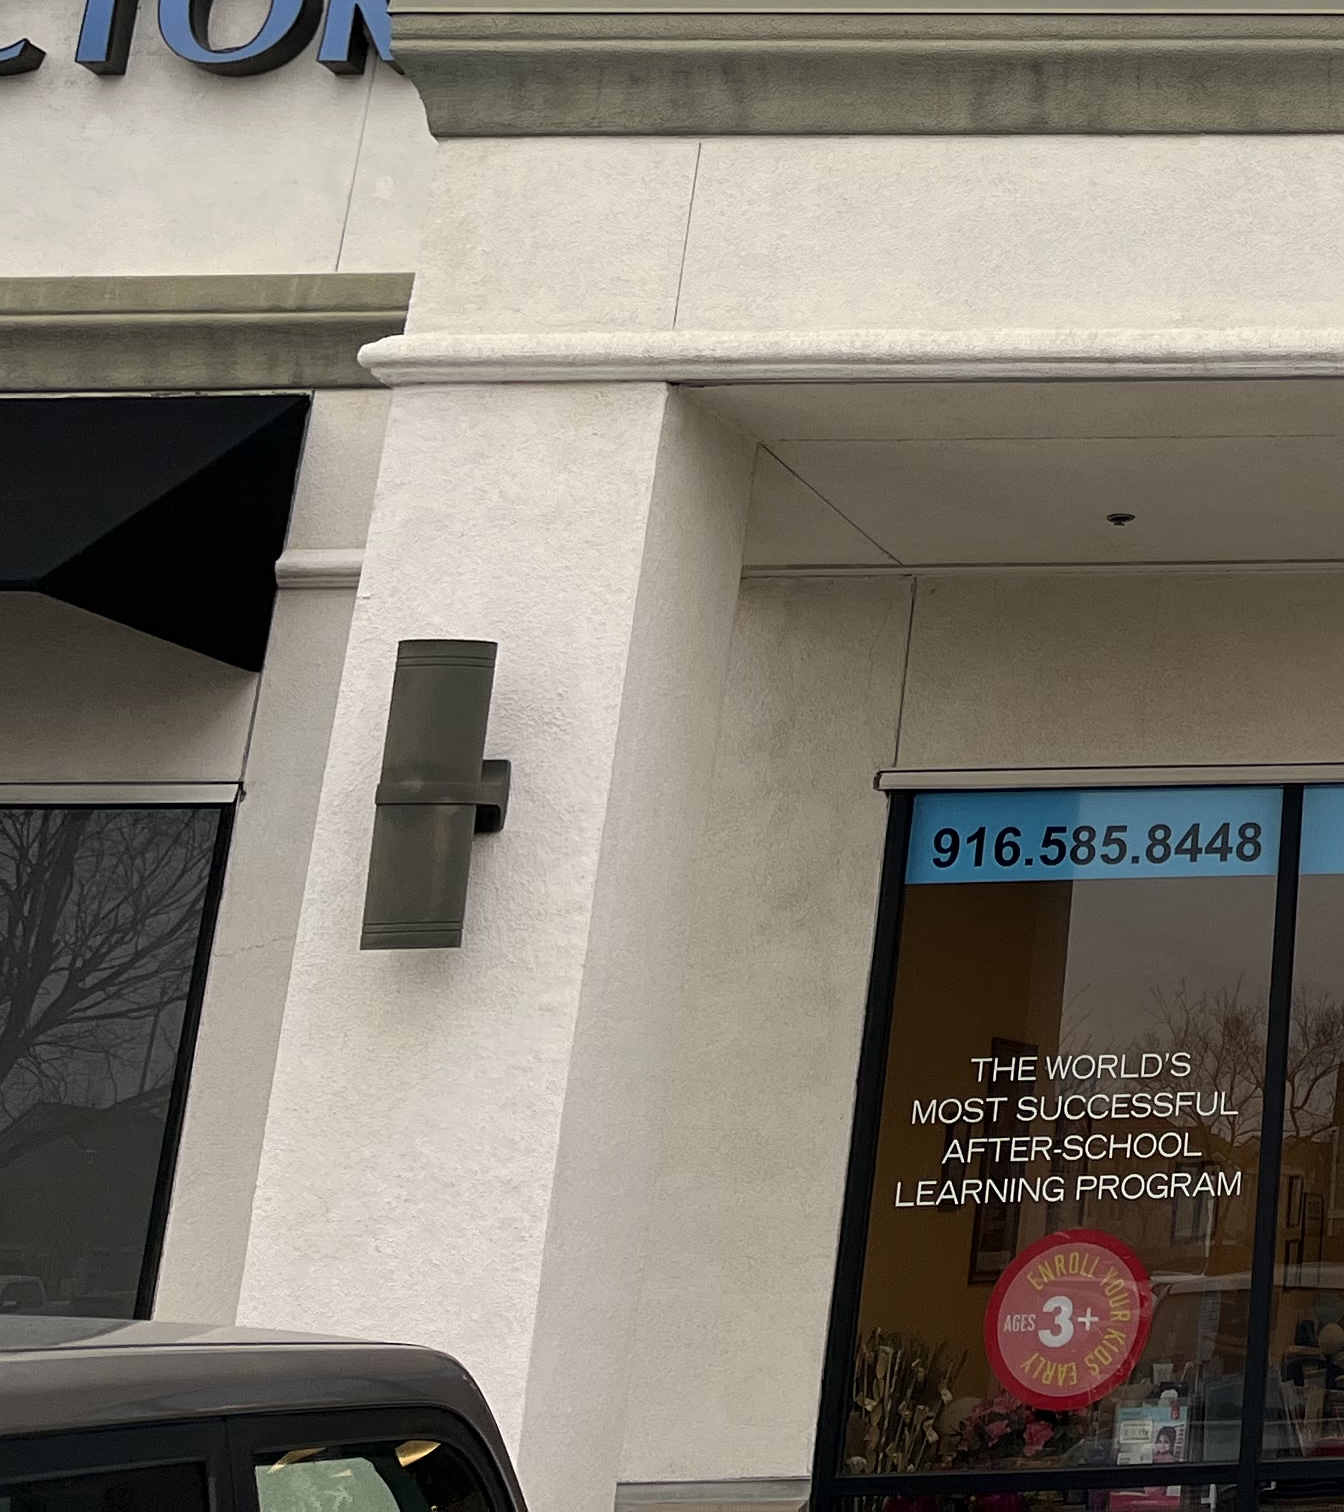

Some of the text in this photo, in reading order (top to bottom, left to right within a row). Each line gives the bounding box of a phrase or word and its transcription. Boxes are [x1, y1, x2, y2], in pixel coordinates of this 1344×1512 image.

[932, 822, 1262, 868] 916.585.8448
[971, 1052, 1192, 1082] THE WORLD'S
[911, 1091, 1239, 1125] MOST SUCCESSFUL
[941, 1132, 1202, 1164] AFTER-SCHOOL
[895, 1172, 1242, 1207] LEARNING PROGRAM
[1003, 1295, 1099, 1348] AGES 3+
[1020, 1252, 1131, 1387] ENROLL YOUR KIDS EARLY
